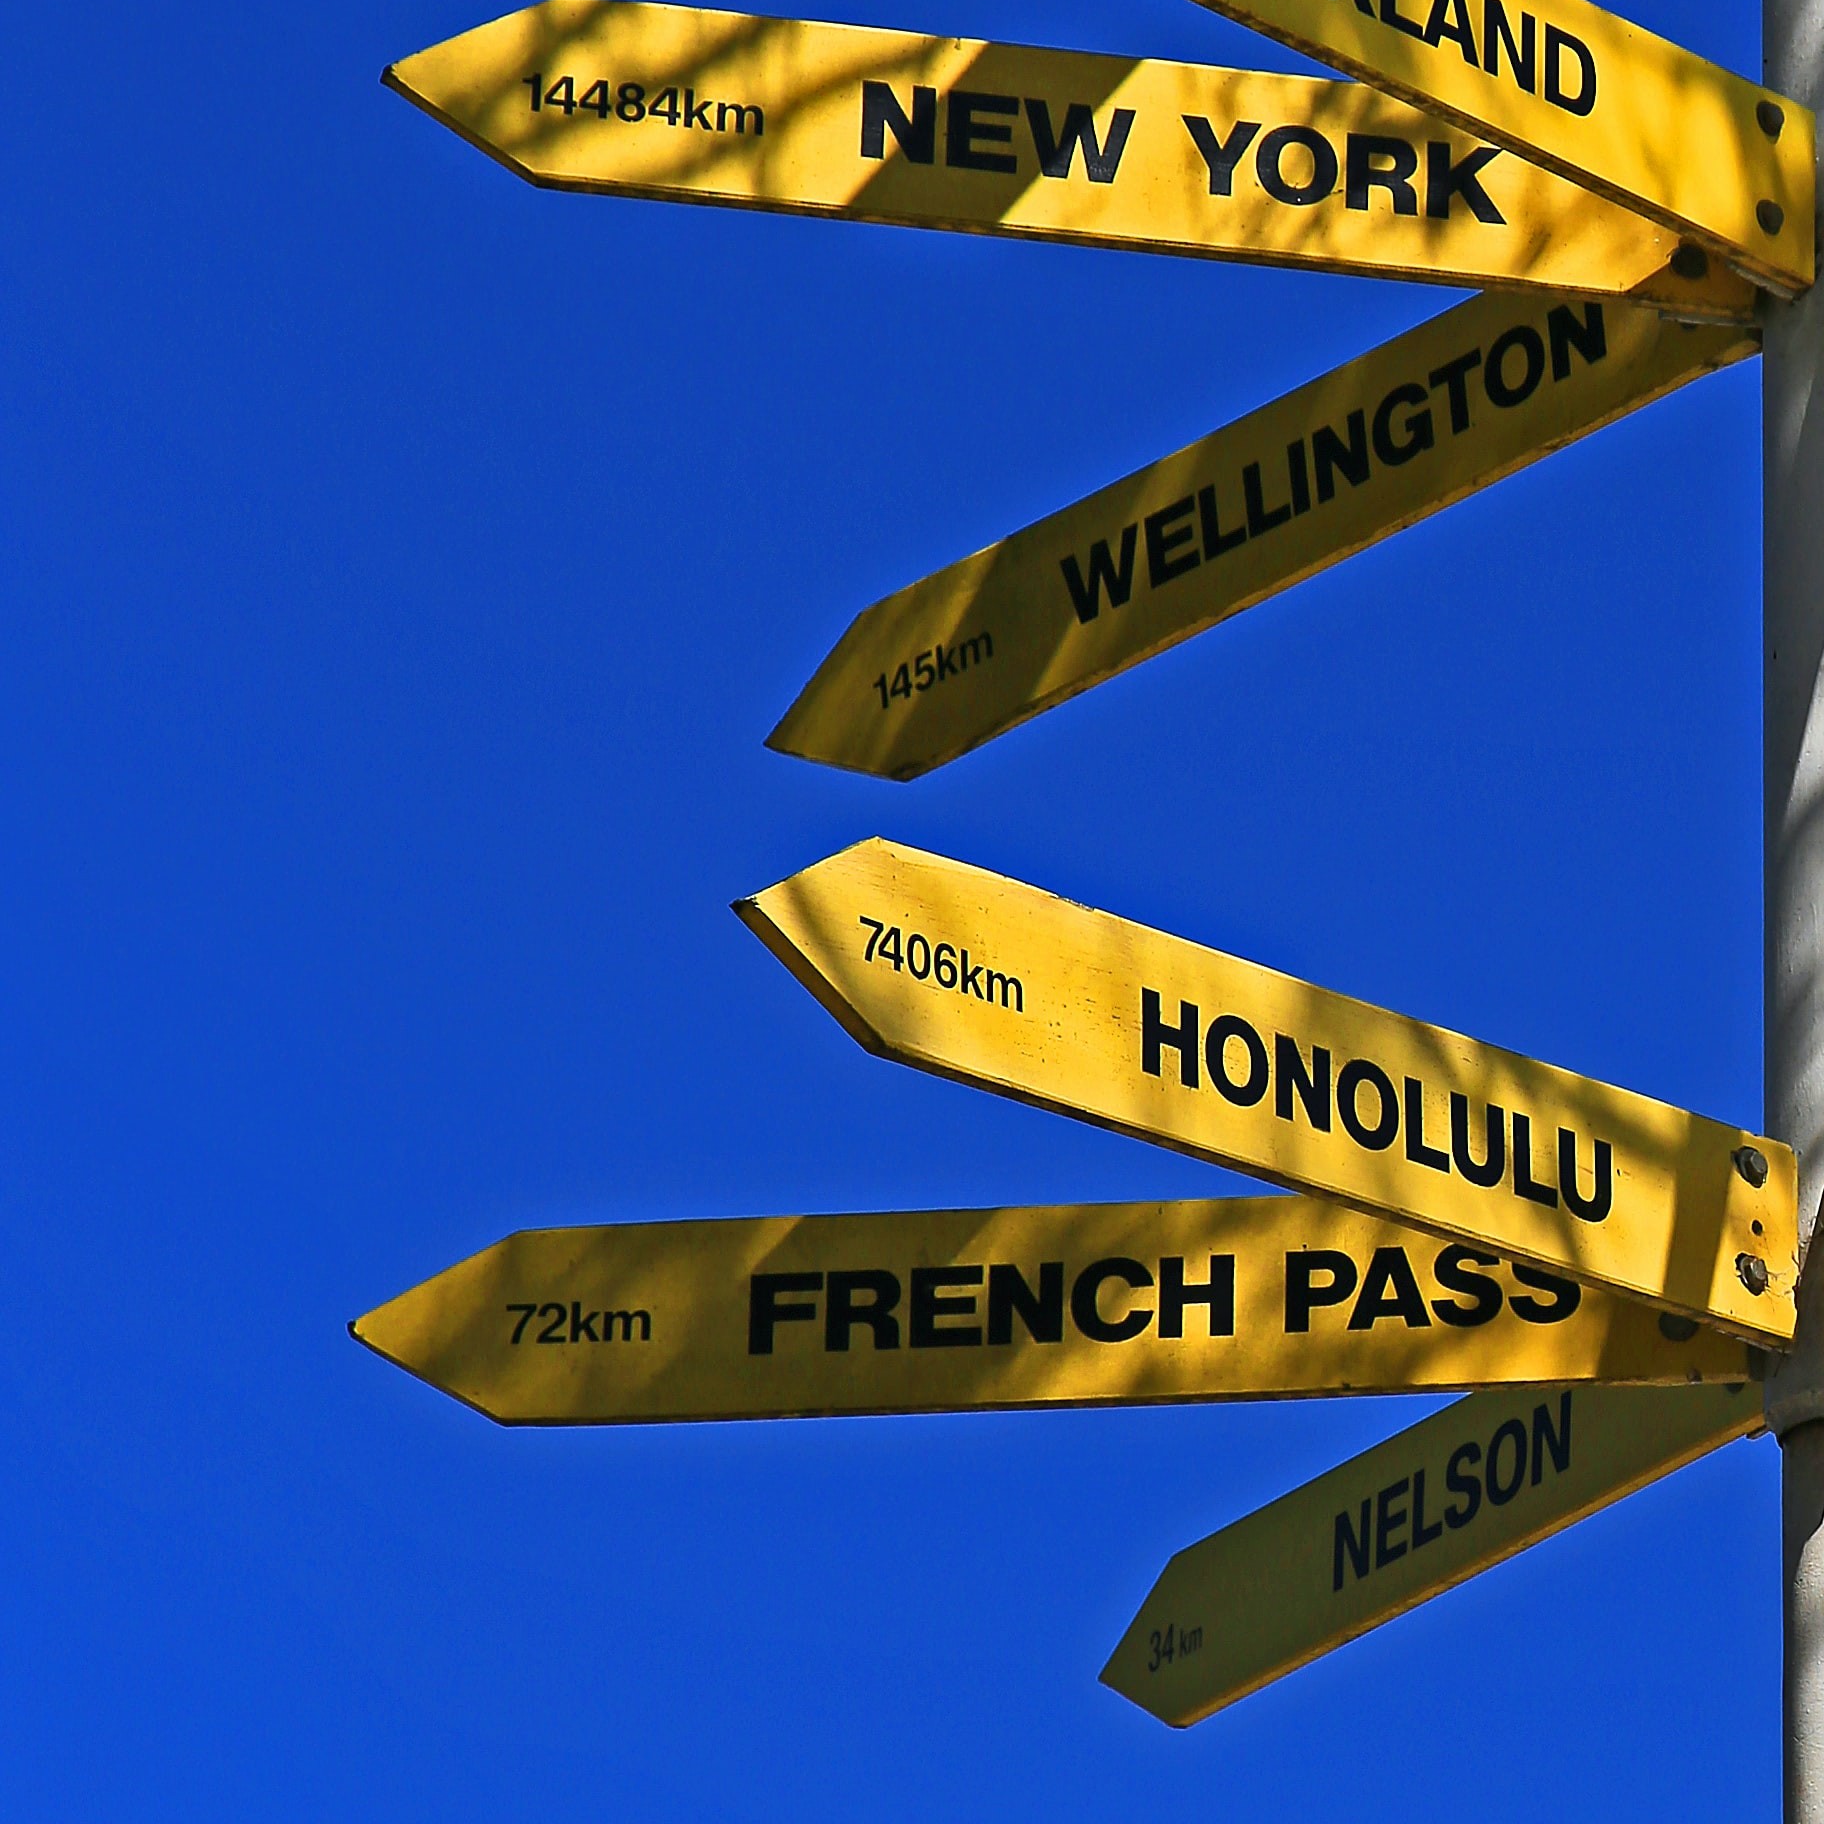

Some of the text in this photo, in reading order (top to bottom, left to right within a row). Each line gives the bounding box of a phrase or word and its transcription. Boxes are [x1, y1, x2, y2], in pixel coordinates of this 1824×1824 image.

[522, 72, 765, 136] 14484km
[861, 80, 1506, 226] NEW YORK
[1060, 299, 1609, 623] WELLINGTON
[872, 626, 995, 709] 145km
[859, 915, 1024, 1012] 7406km
[1141, 987, 1614, 1224] HONOLULU
[506, 1302, 653, 1346] 72km
[748, 1241, 1581, 1356] FRENCH PASS
[1332, 1390, 1572, 1592] NELSON
[1148, 1623, 1174, 1673] 34
